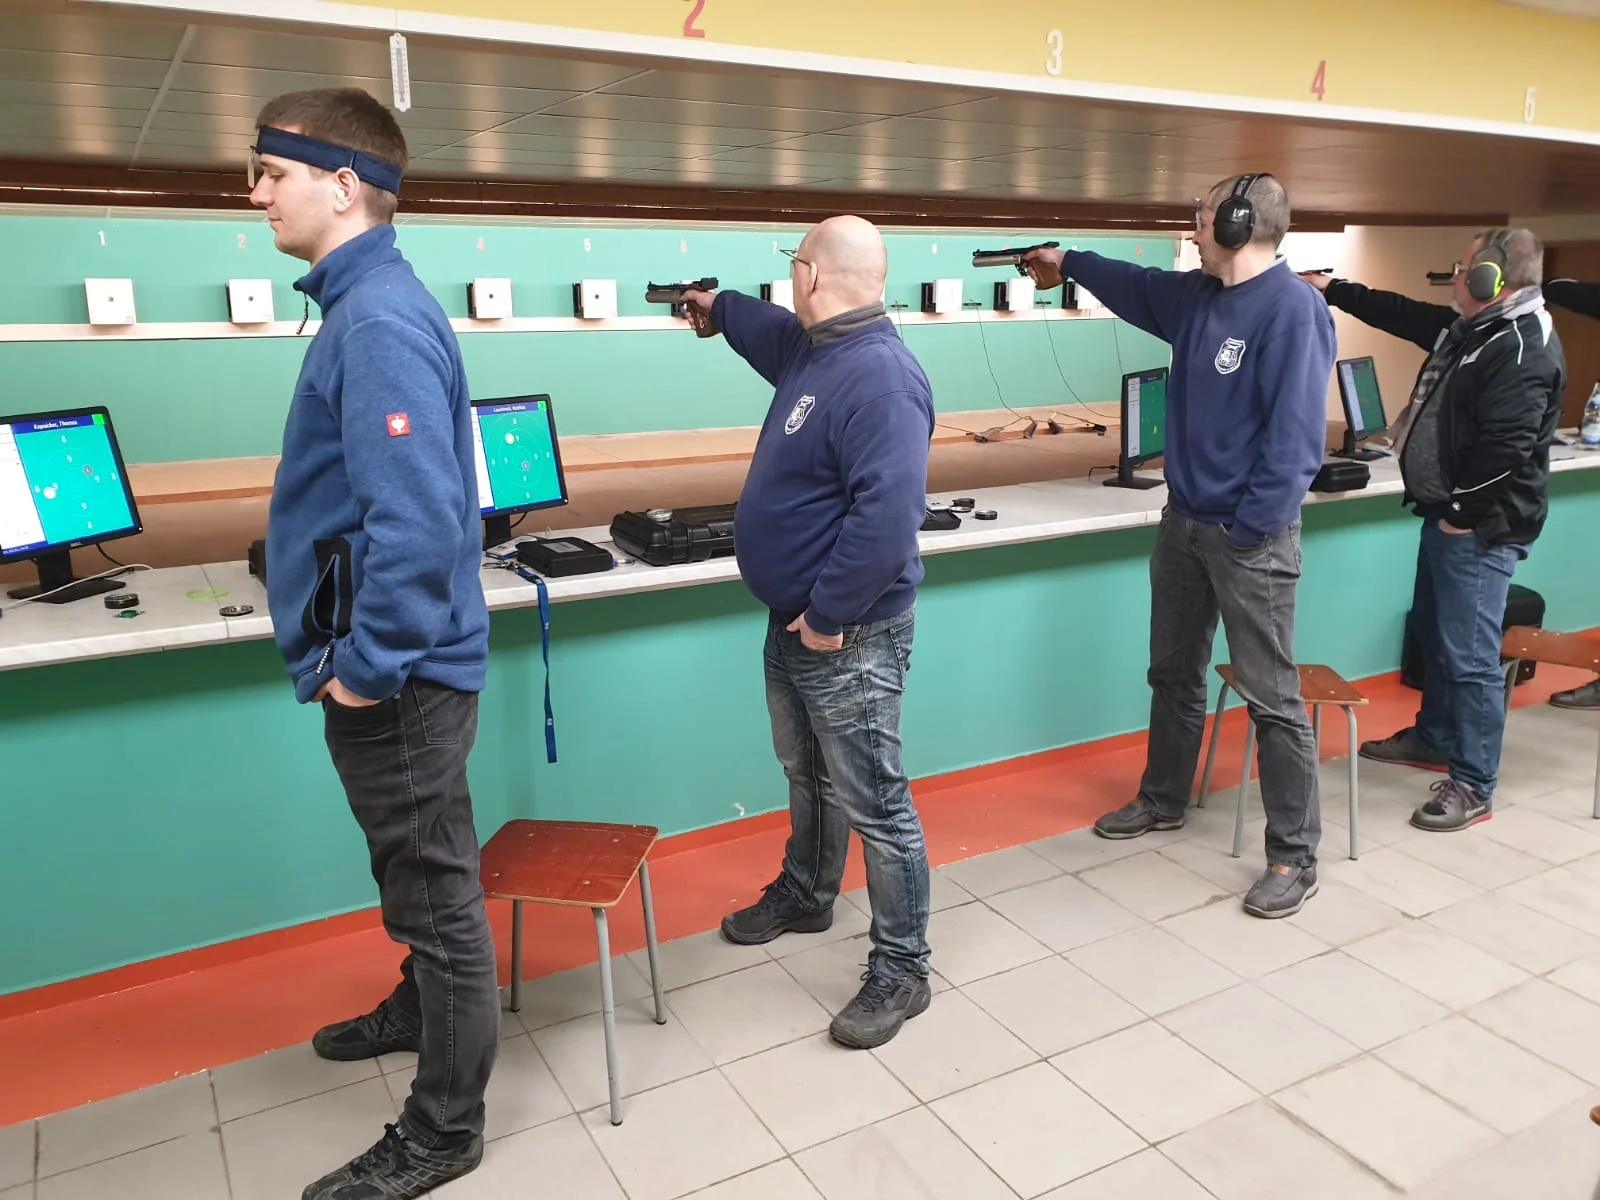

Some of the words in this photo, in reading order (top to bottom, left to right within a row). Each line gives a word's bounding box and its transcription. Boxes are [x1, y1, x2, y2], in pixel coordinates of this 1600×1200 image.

[683, 0, 706, 38] 2
[1046, 28, 1064, 76] 3
[1310, 59, 1327, 102] 4
[98, 230, 106, 246] 1
[237, 233, 247, 250] 2
[476, 236, 486, 251] 4
[584, 237, 592, 252] 5
[771, 240, 779, 255] 7
